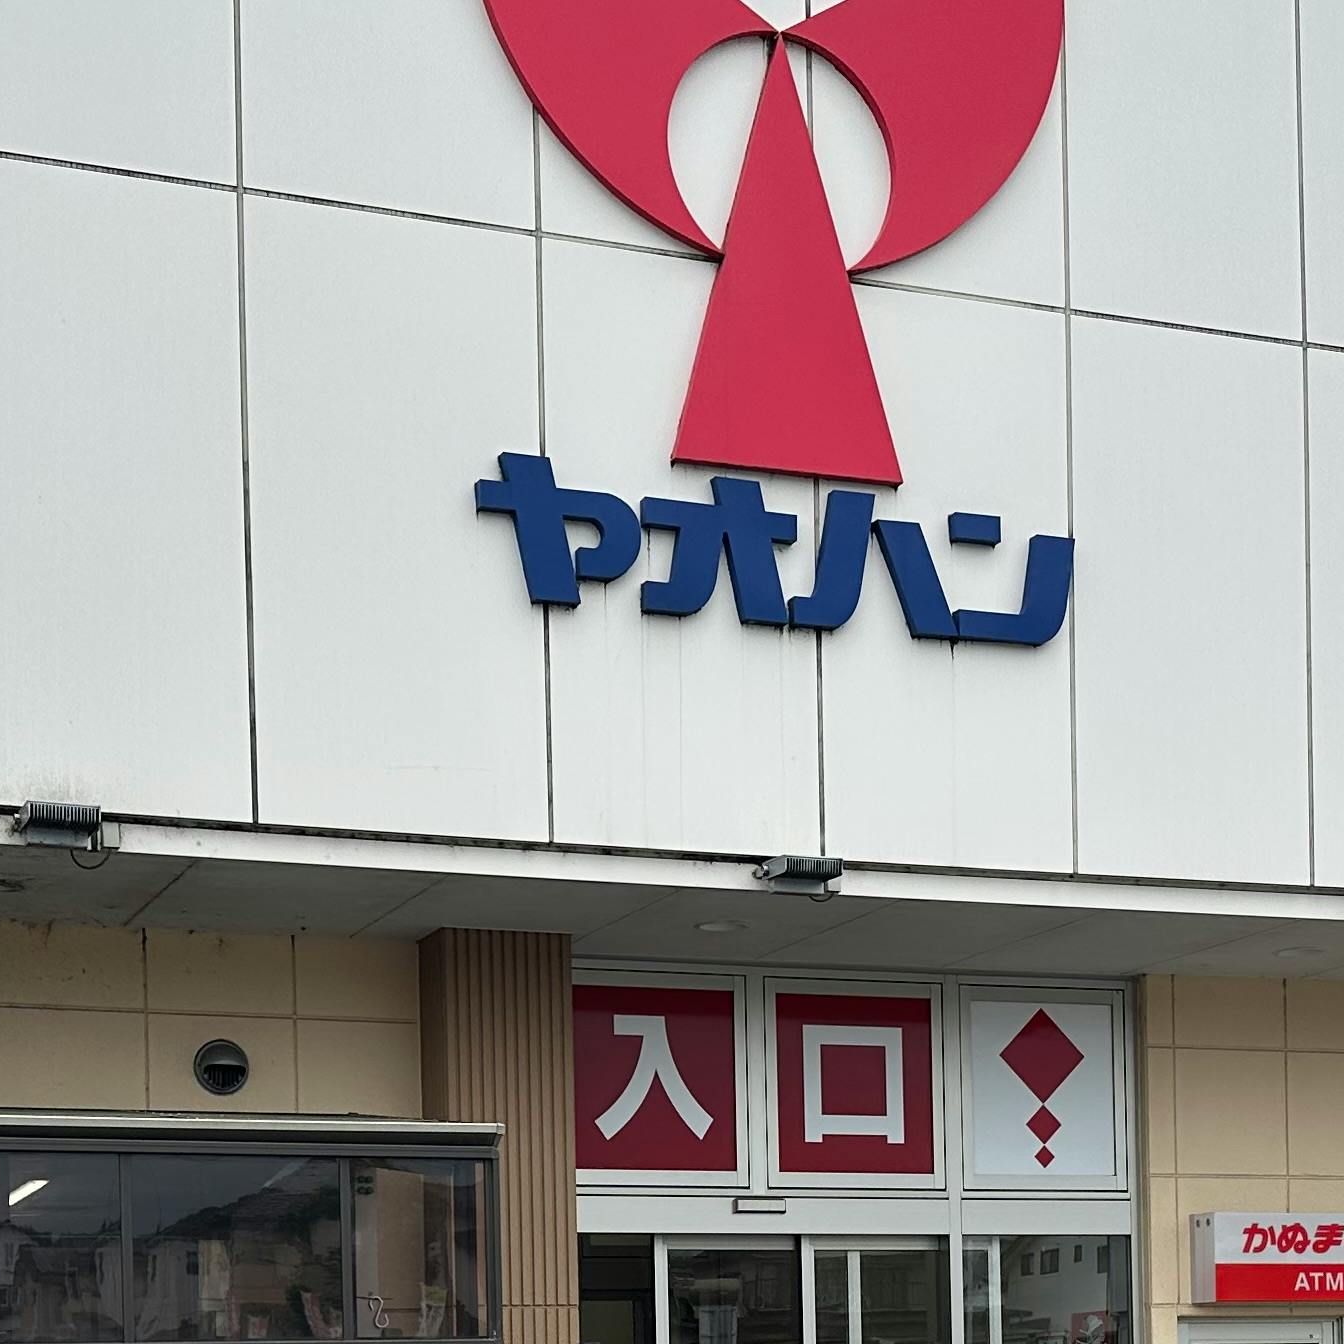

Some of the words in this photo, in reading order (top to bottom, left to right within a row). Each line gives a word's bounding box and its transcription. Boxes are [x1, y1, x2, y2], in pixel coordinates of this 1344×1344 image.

[475, 452, 1076, 648] ヤオハン
[594, 1014, 905, 1145] 入口
